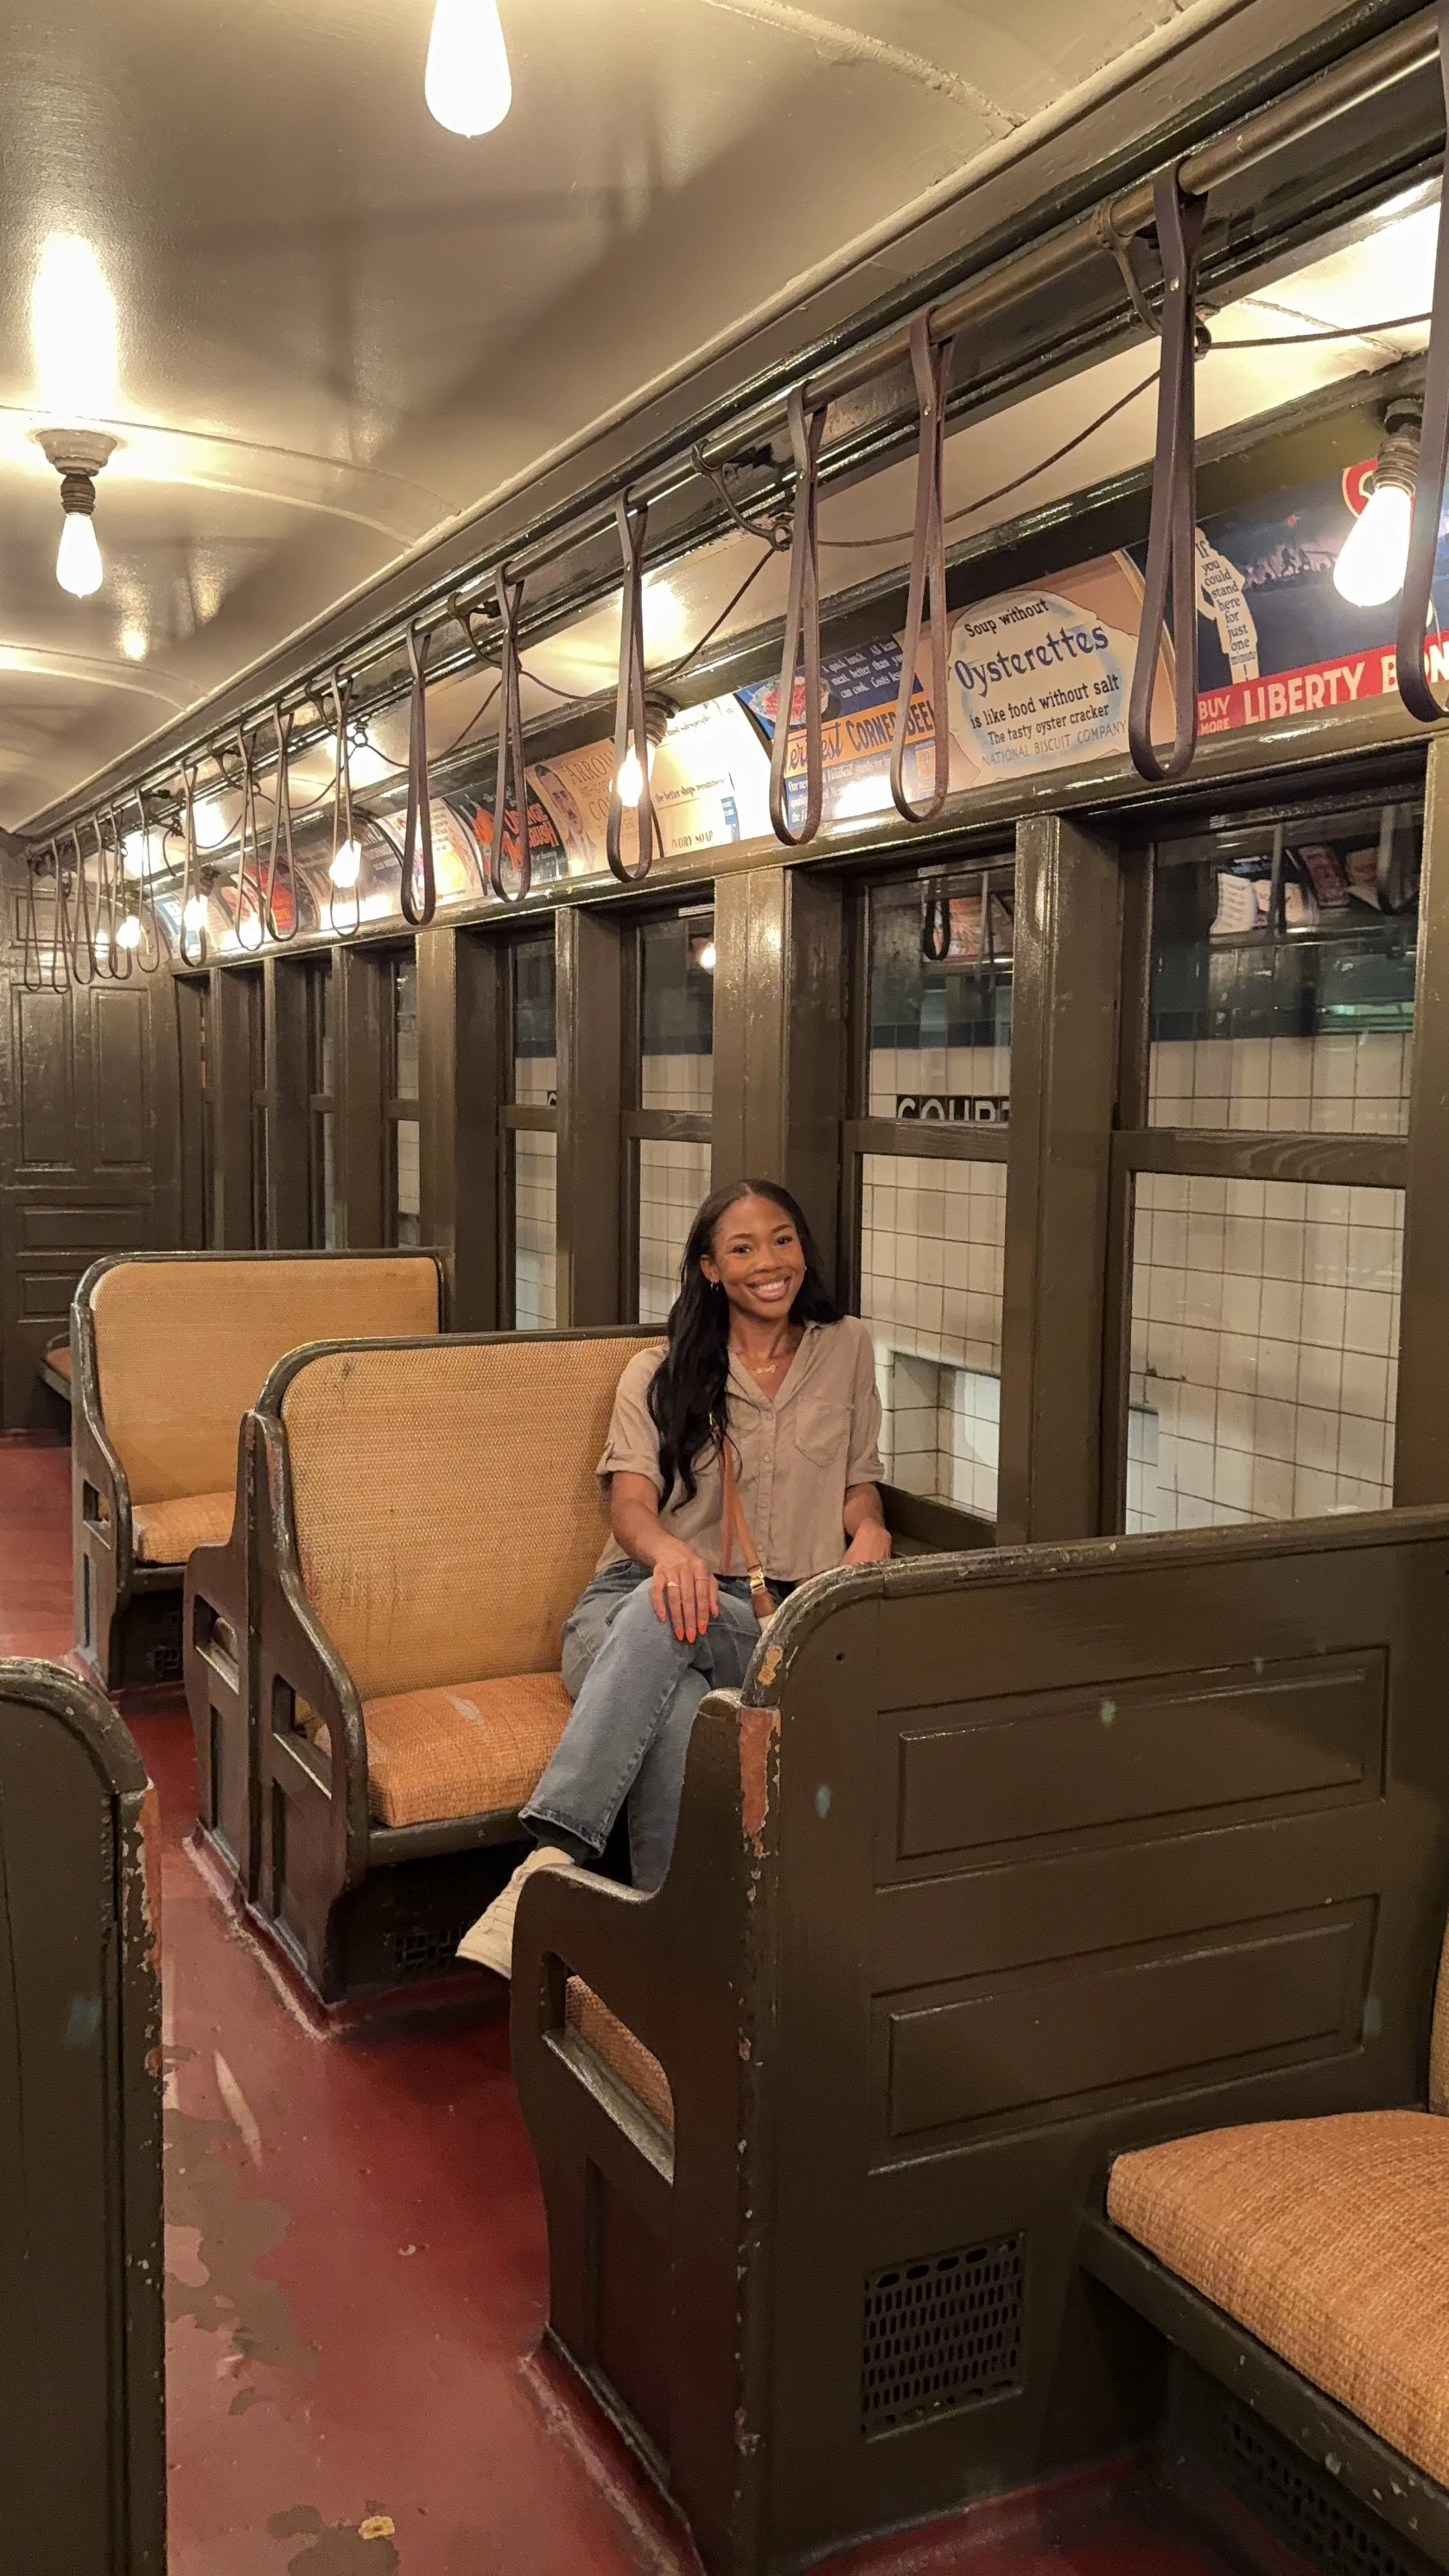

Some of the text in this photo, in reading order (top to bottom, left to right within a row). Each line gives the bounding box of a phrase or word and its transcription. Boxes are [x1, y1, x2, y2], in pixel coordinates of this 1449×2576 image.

[1195, 540, 1209, 558] If
[1201, 560, 1220, 576] you
[1204, 569, 1232, 586] could
[1212, 581, 1239, 599] stand
[1216, 596, 1240, 611] here
[965, 598, 1049, 638] Soup without
[1225, 611, 1239, 624] for
[1226, 624, 1248, 644] just
[1231, 639, 1250, 651] one
[872, 659, 890, 670] than
[955, 626, 1109, 698] Oysterettes
[971, 674, 1120, 729] is like food without salt
[1244, 662, 1366, 725] LIBERTY
[1198, 695, 1230, 720] BUY
[987, 704, 1110, 745] The tasty oyster cracker
[1200, 717, 1230, 735] MORE
[982, 720, 1127, 765] NATIONAL BISCUIT COMPANY
[663, 790, 680, 800] better
